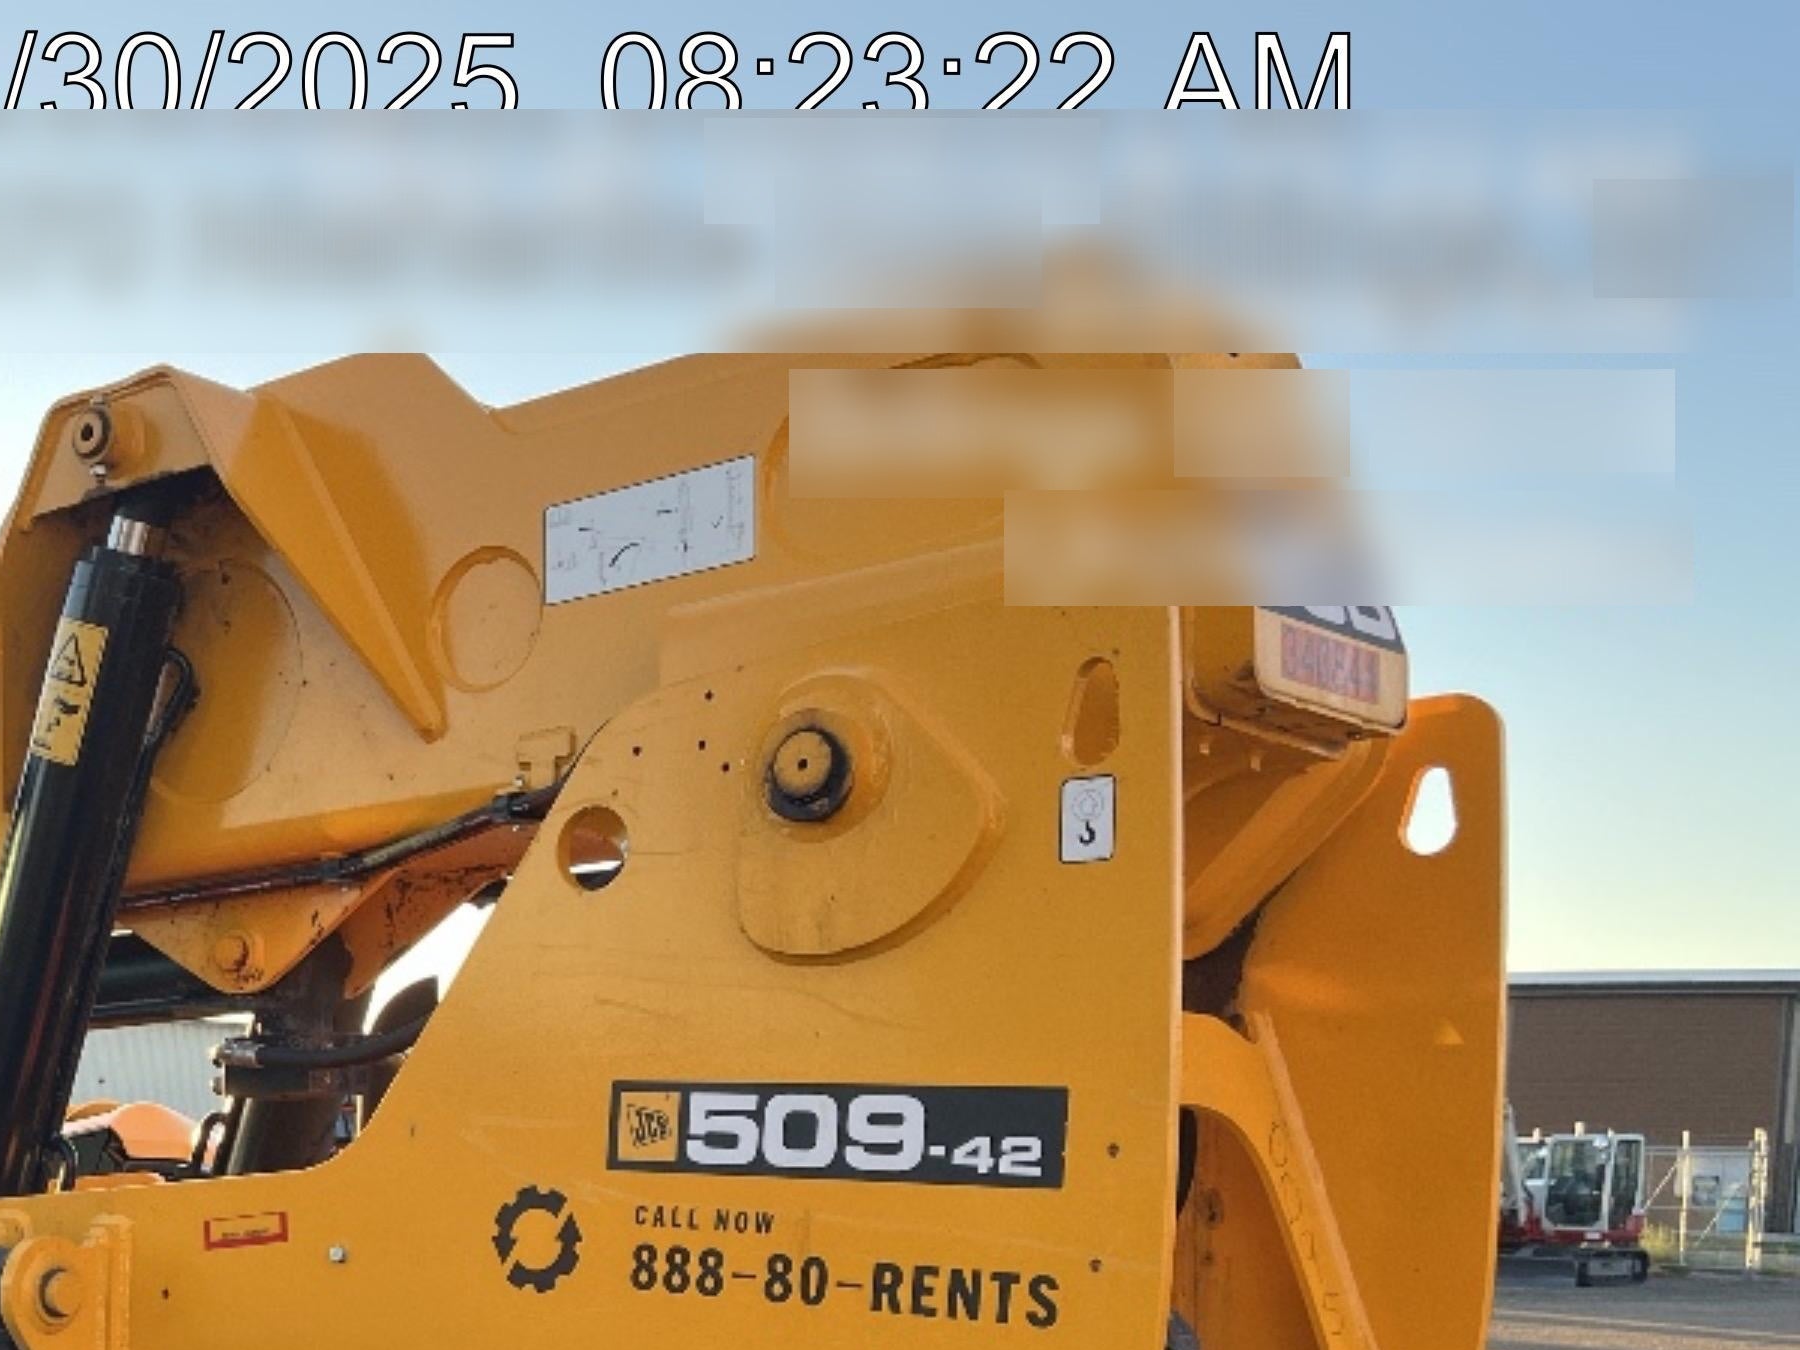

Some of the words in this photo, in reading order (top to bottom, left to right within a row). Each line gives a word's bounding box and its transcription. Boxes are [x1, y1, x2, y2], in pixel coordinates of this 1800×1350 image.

[685, 1091, 1043, 1179] 509-42
[634, 1205, 701, 1231] CALL
[713, 1208, 775, 1235] NOW
[629, 1243, 1061, 1329] 888-80-RENTS
